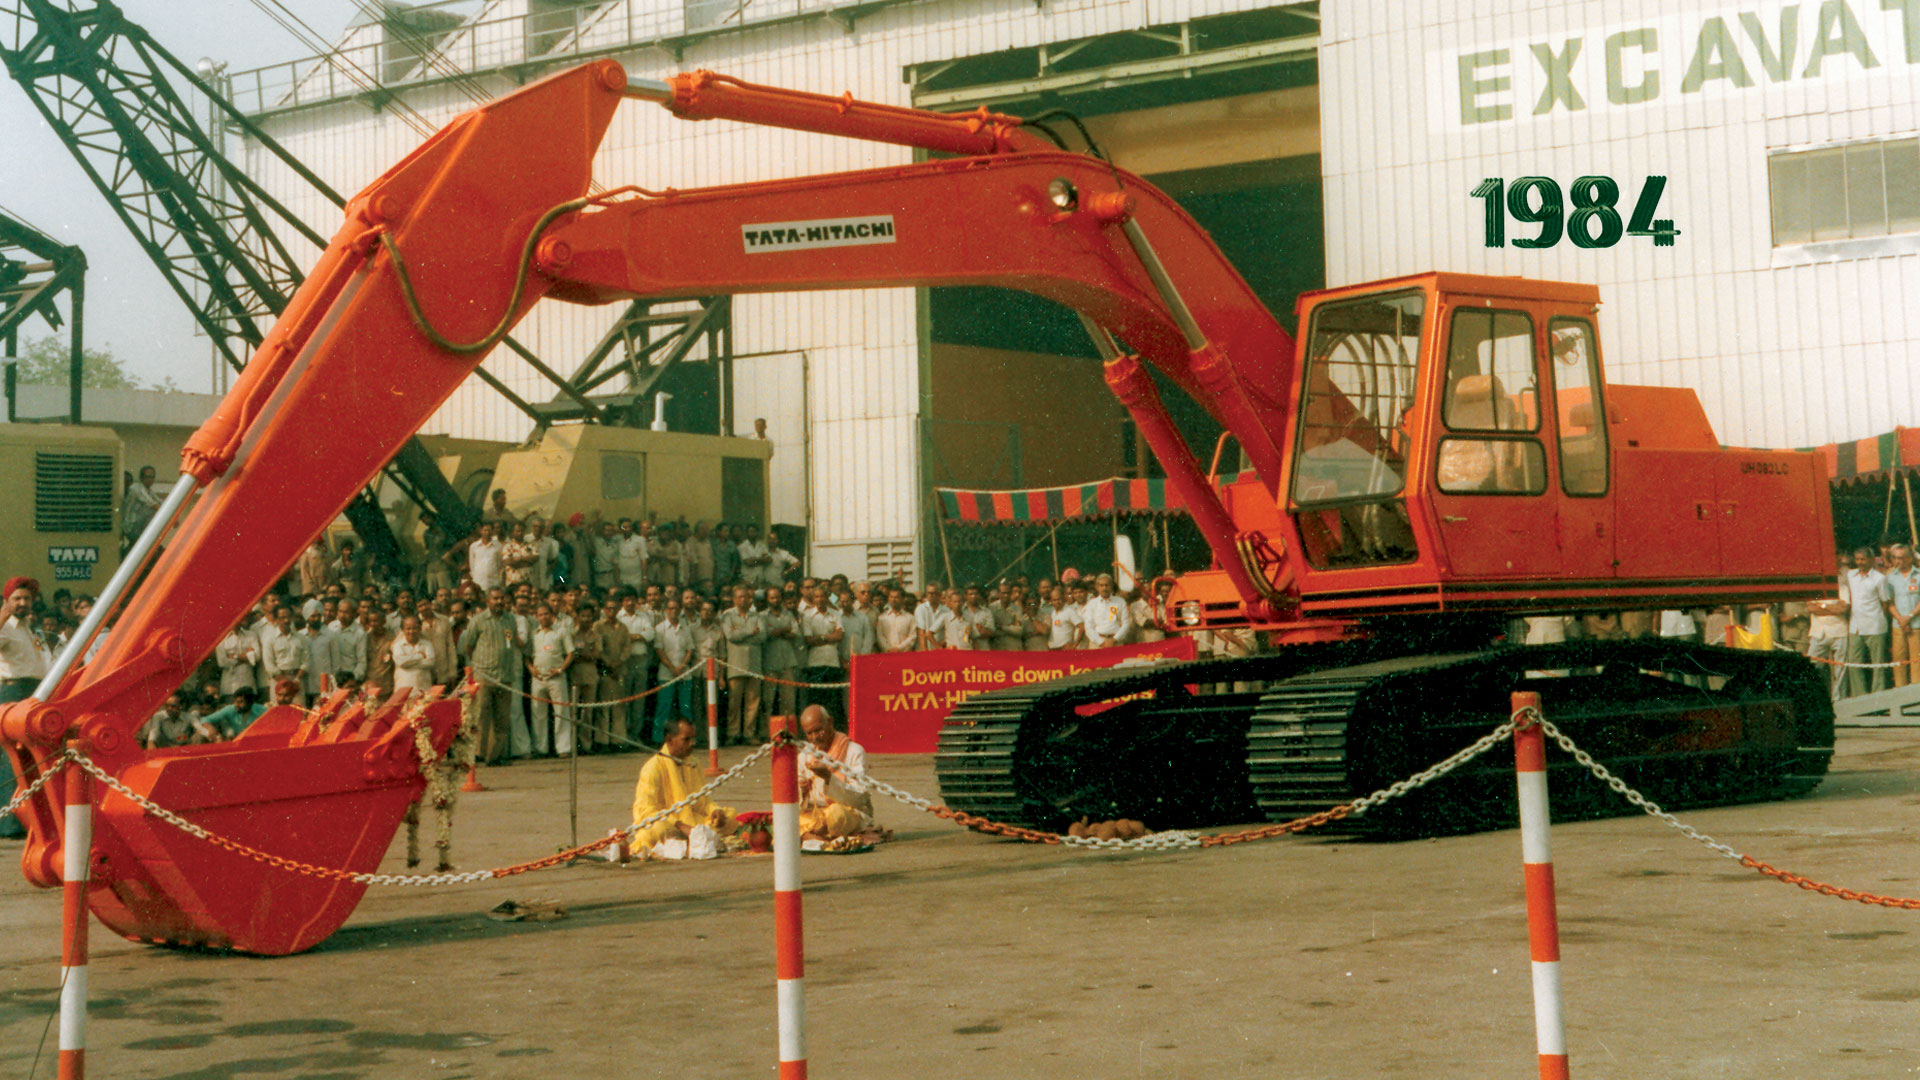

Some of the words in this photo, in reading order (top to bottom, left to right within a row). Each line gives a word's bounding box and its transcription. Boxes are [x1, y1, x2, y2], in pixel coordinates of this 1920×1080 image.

[745, 222, 894, 246] TATA-HITACHI
[50, 548, 97, 561] TATA
[902, 668, 956, 686] Down
[962, 666, 1006, 683] time
[1012, 666, 1063, 683] down
[879, 690, 989, 711] TATA-HI
